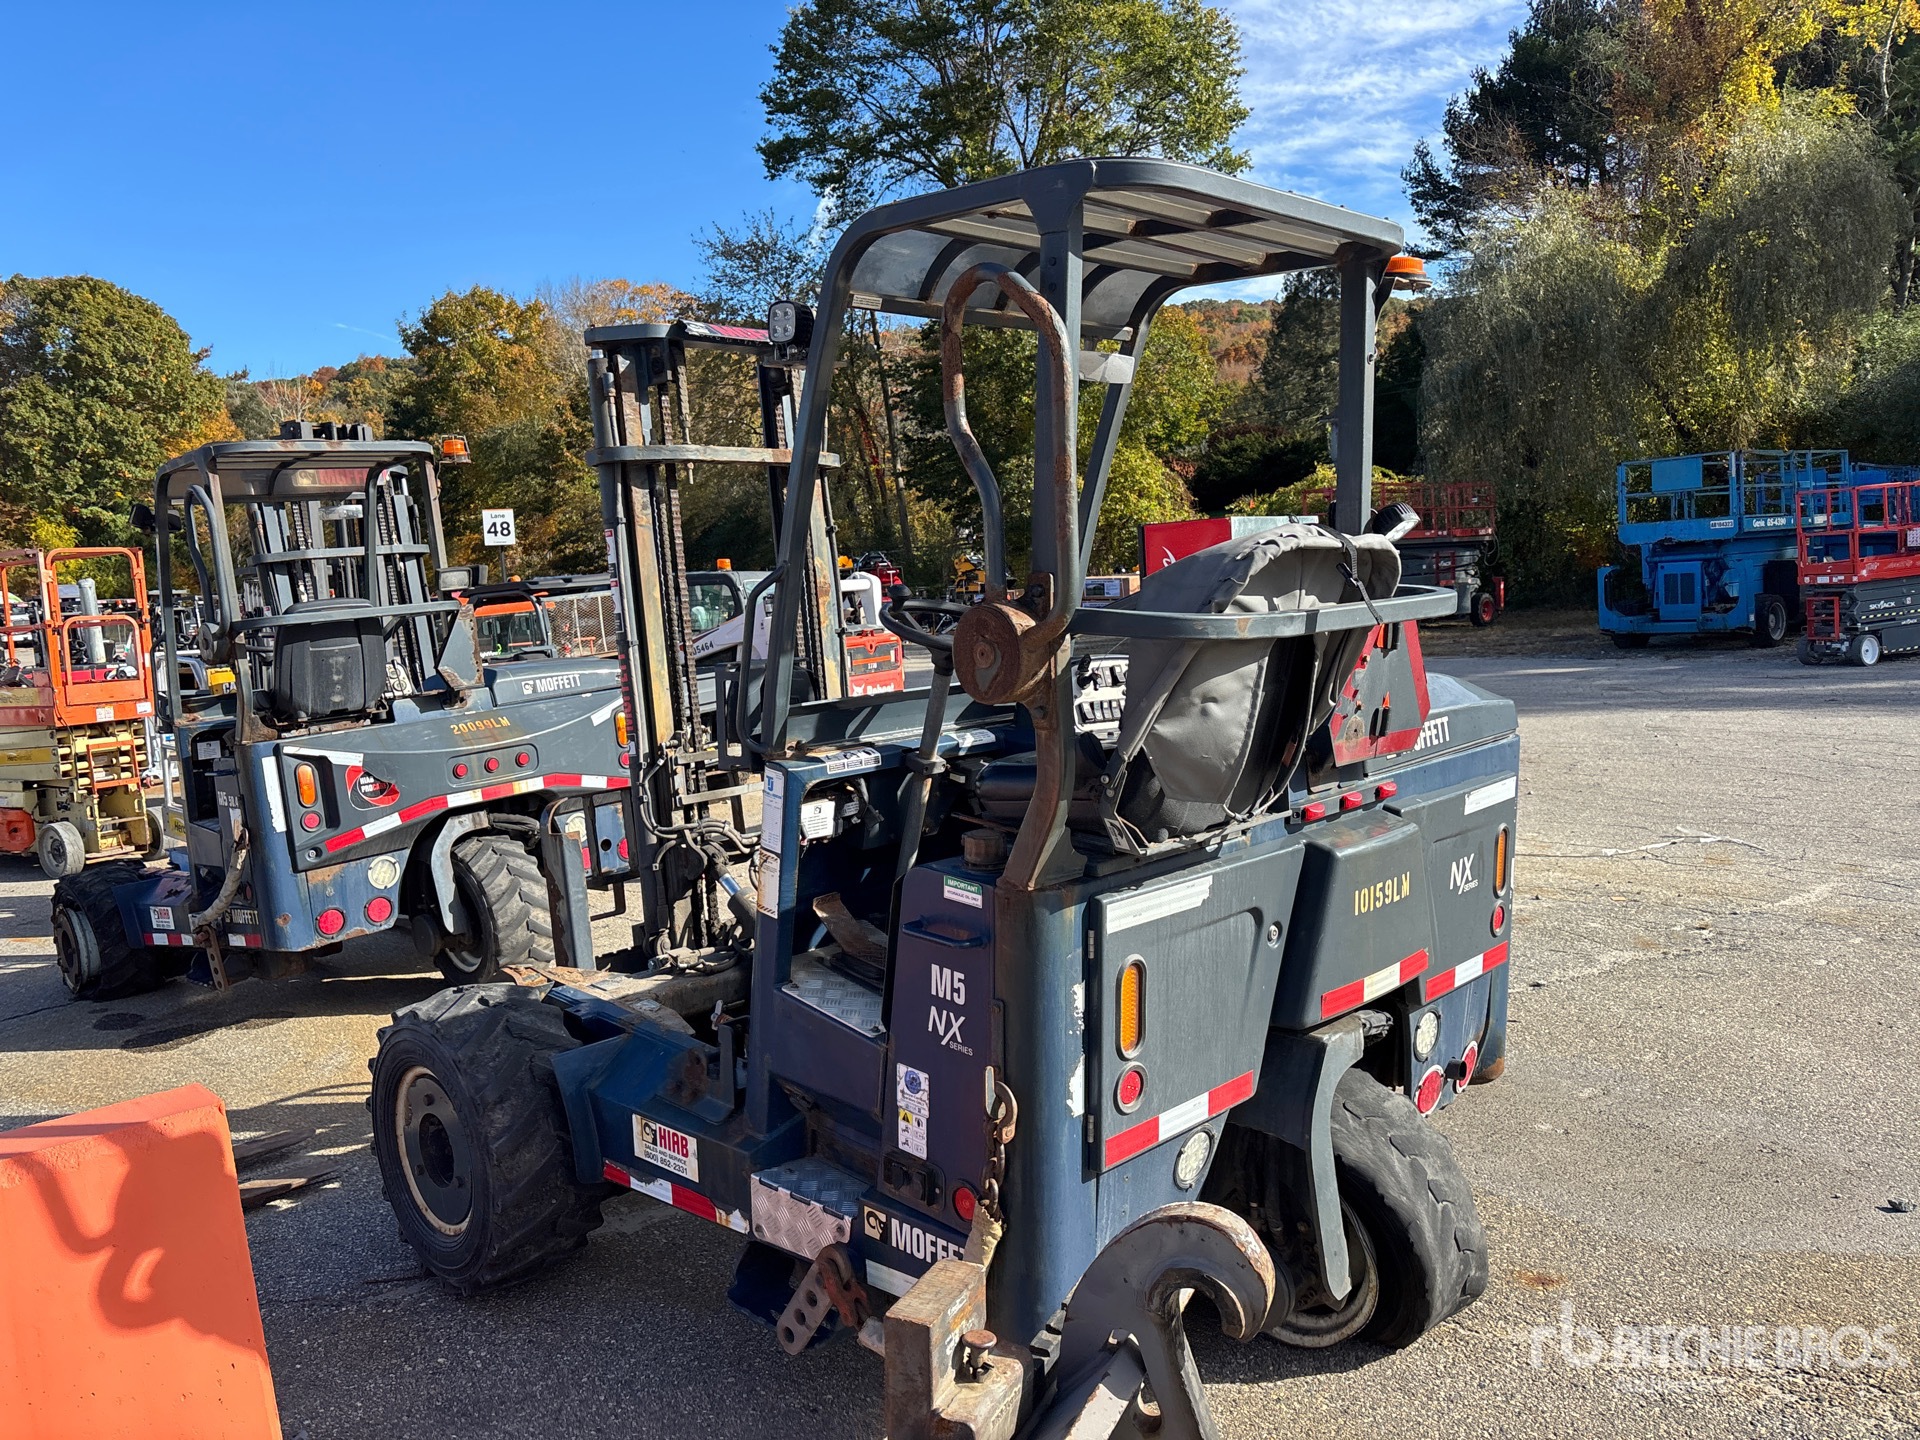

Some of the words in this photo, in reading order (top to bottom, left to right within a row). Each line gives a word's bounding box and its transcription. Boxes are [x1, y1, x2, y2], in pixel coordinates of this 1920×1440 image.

[487, 521, 511, 537] 48
[222, 682, 237, 694] CA
[535, 675, 581, 693] MOFFETT
[450, 716, 511, 735] 20099LM
[1450, 853, 1475, 895] NX
[947, 879, 978, 893] IMPORTANT
[1354, 872, 1410, 916] 10159LM
[1463, 879, 1478, 892] SERIES
[231, 908, 259, 925] MOFFETT
[931, 963, 966, 1006] M5
[928, 1005, 966, 1046] NX
[949, 1041, 973, 1056] SERIES
[658, 1126, 689, 1159] HIAB
[644, 1143, 658, 1153] SALES
[659, 1150, 667, 1158] AND
[668, 1154, 687, 1166] SERVICE
[644, 1150, 659, 1163] (800)
[660, 1158, 688, 1176] 852-2331
[891, 1217, 965, 1264] MOFFE
